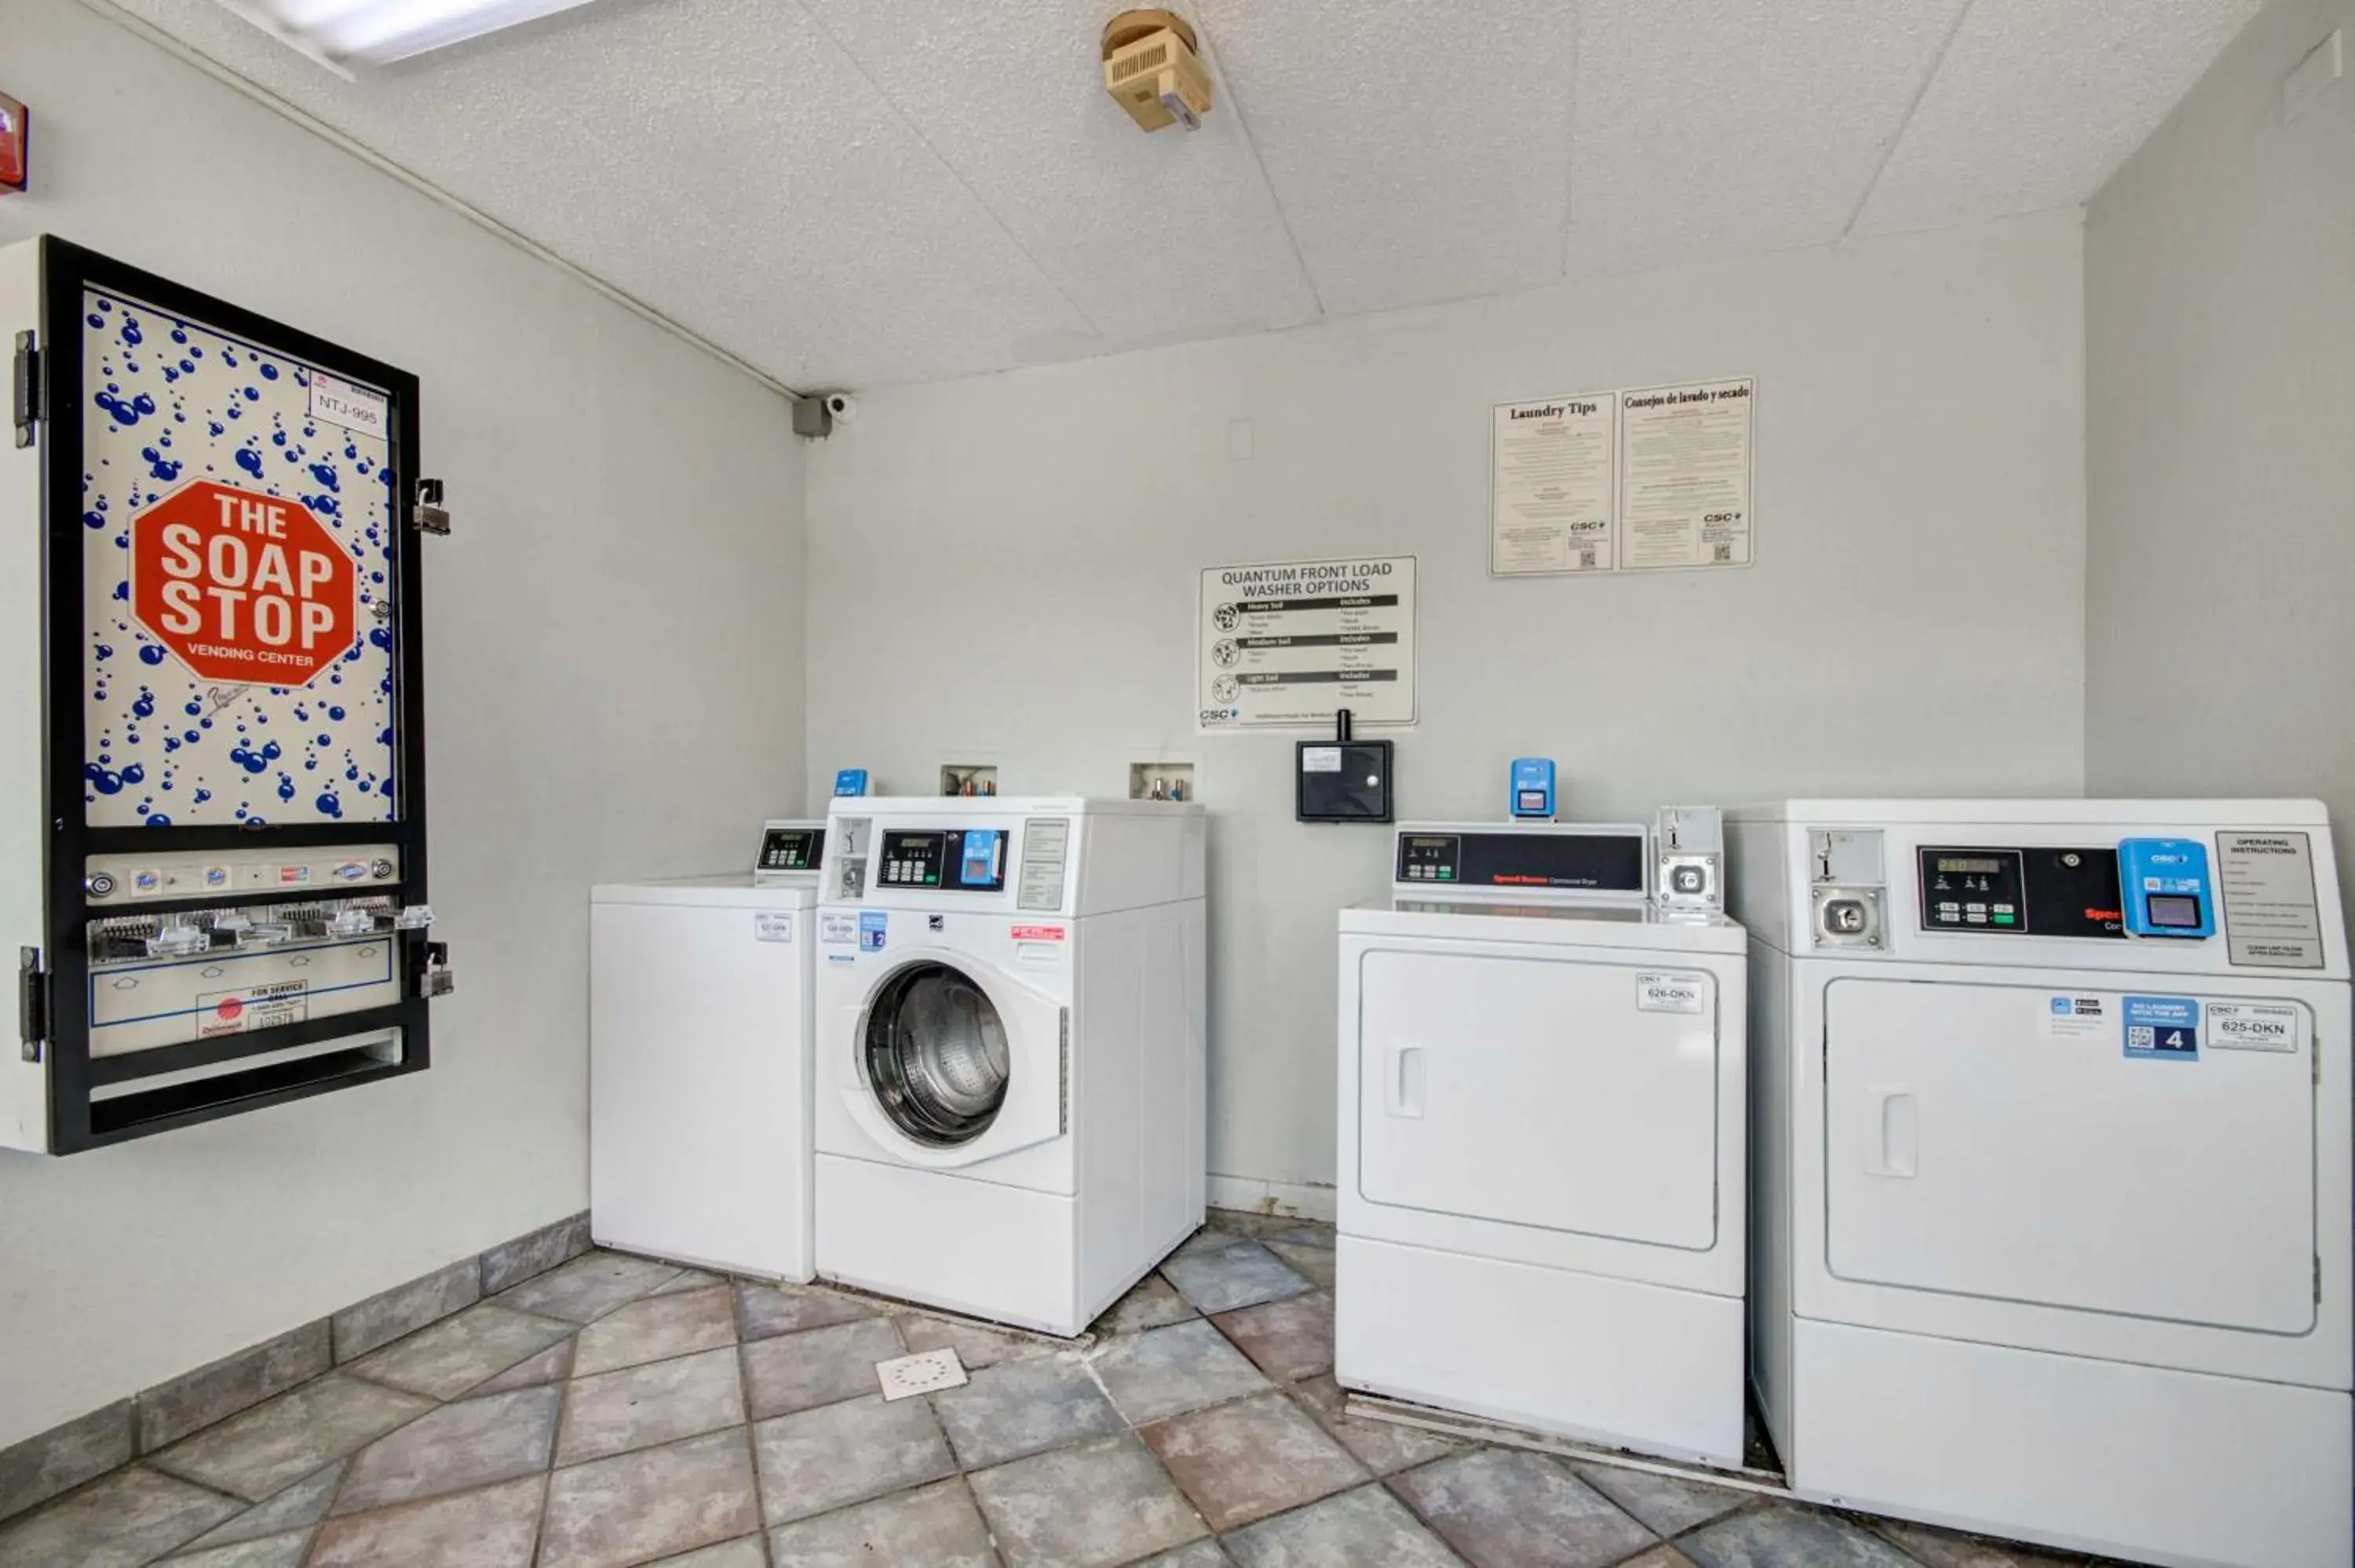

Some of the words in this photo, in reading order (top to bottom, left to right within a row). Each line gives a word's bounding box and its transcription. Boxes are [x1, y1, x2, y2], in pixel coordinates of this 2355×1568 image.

[1625, 396, 1664, 409] Consejos
[1667, 392, 1678, 403] de
[1680, 389, 1708, 403] lavado
[1711, 392, 1716, 403] y
[1718, 385, 1749, 399] secado
[319, 395, 377, 425] NTJ-995
[1510, 404, 1565, 419] Laundry
[1568, 402, 1597, 416] Tips
[214, 493, 287, 539] THE
[161, 523, 333, 599] SOAP
[1222, 568, 1296, 585] QUANTUM
[1301, 566, 1347, 579] FRONT
[1353, 563, 1392, 577] LOAD
[1243, 582, 1302, 596] WASHER
[1305, 579, 1370, 594] OPTIONS
[161, 580, 334, 650] STOP
[187, 643, 254, 661] VENDING
[257, 651, 313, 666] CENTER
[1199, 709, 1229, 720] CSC
[2222, 1021, 2285, 1034] 625-DKN
[2165, 1030, 2184, 1048] 4
